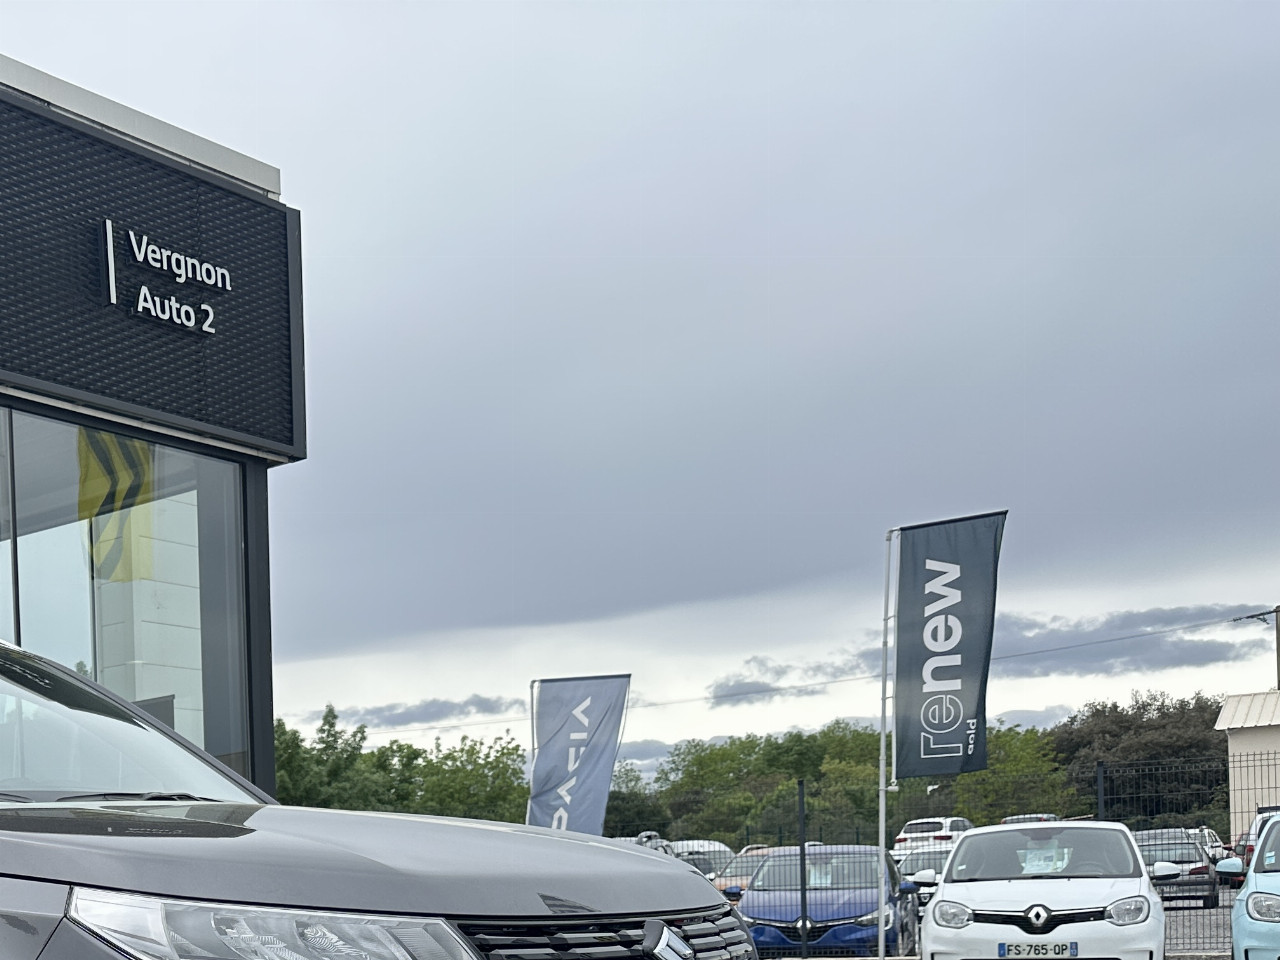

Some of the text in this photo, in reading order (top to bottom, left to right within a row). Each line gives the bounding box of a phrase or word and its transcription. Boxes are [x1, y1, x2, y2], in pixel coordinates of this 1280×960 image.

[128, 230, 232, 291] Vergnon
[137, 285, 216, 334] Auto 2
[920, 558, 964, 759] renew
